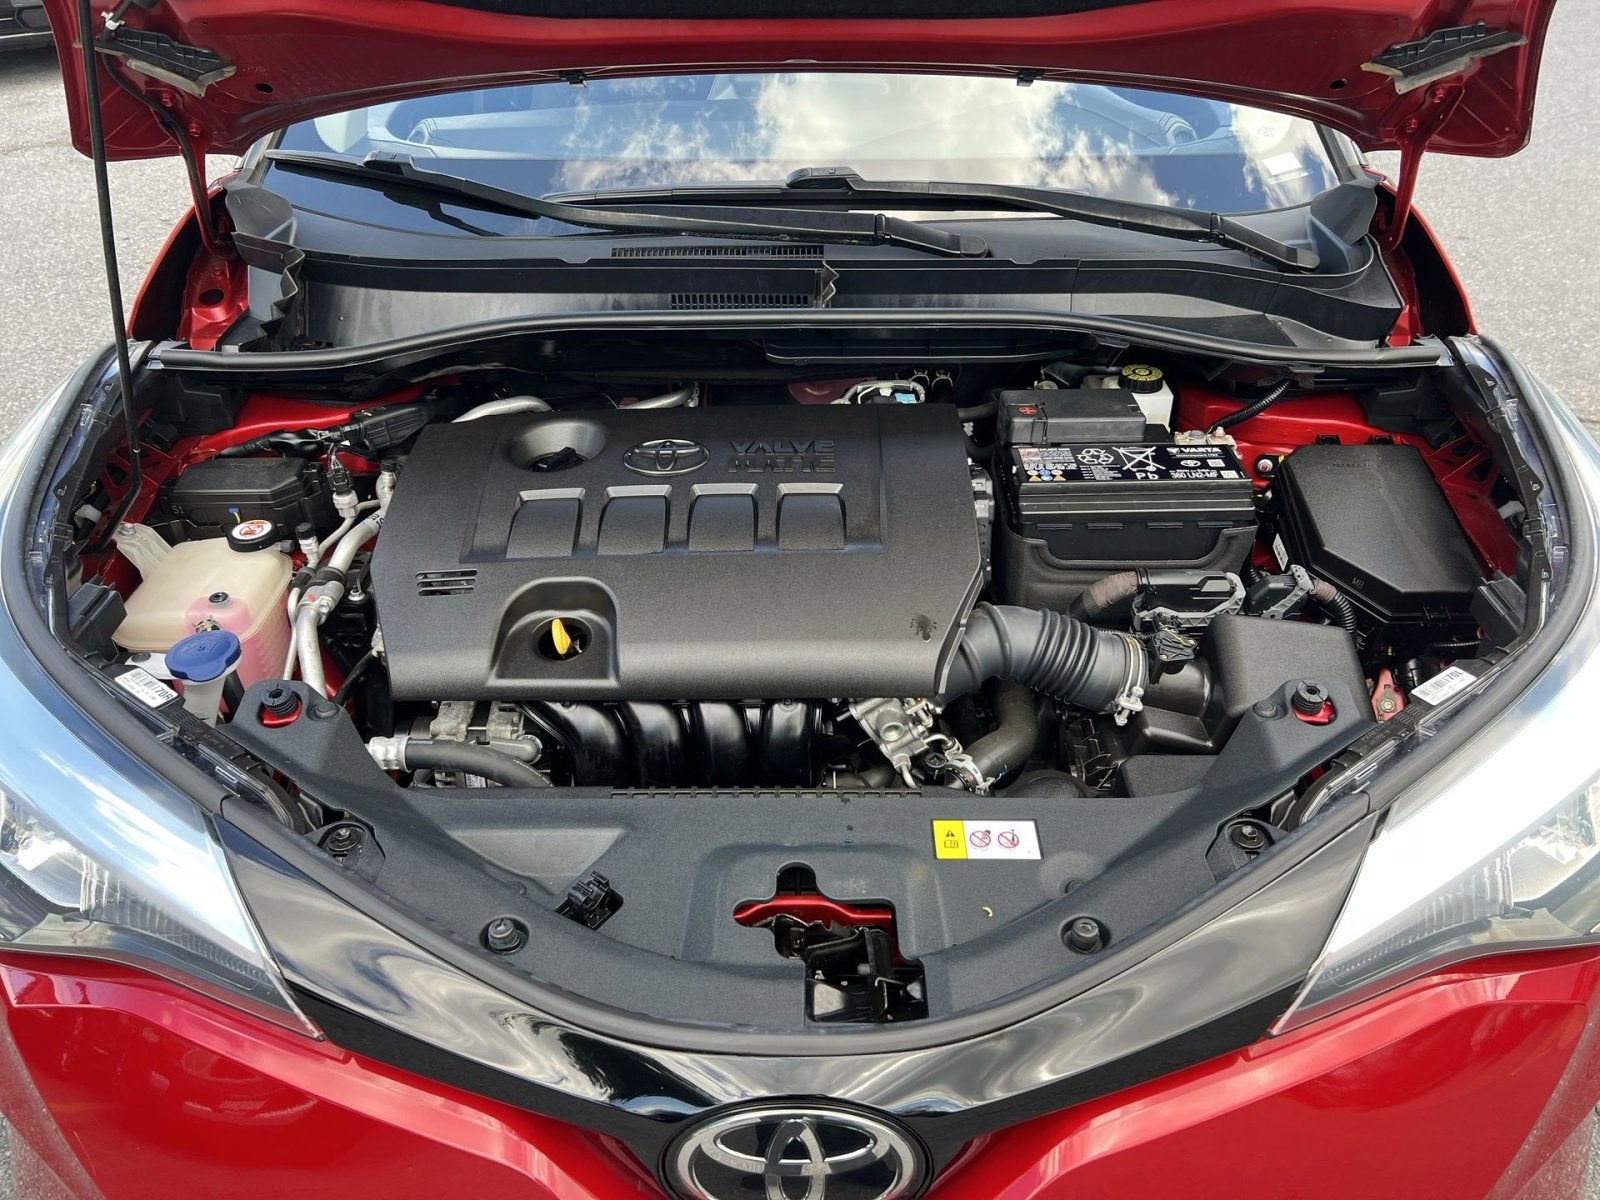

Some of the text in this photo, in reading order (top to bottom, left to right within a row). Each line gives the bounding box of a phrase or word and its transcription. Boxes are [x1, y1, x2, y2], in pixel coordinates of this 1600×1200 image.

[729, 440, 835, 455] VALVE
[1135, 472, 1159, 480] Pb
[171, 505, 184, 514] S1
